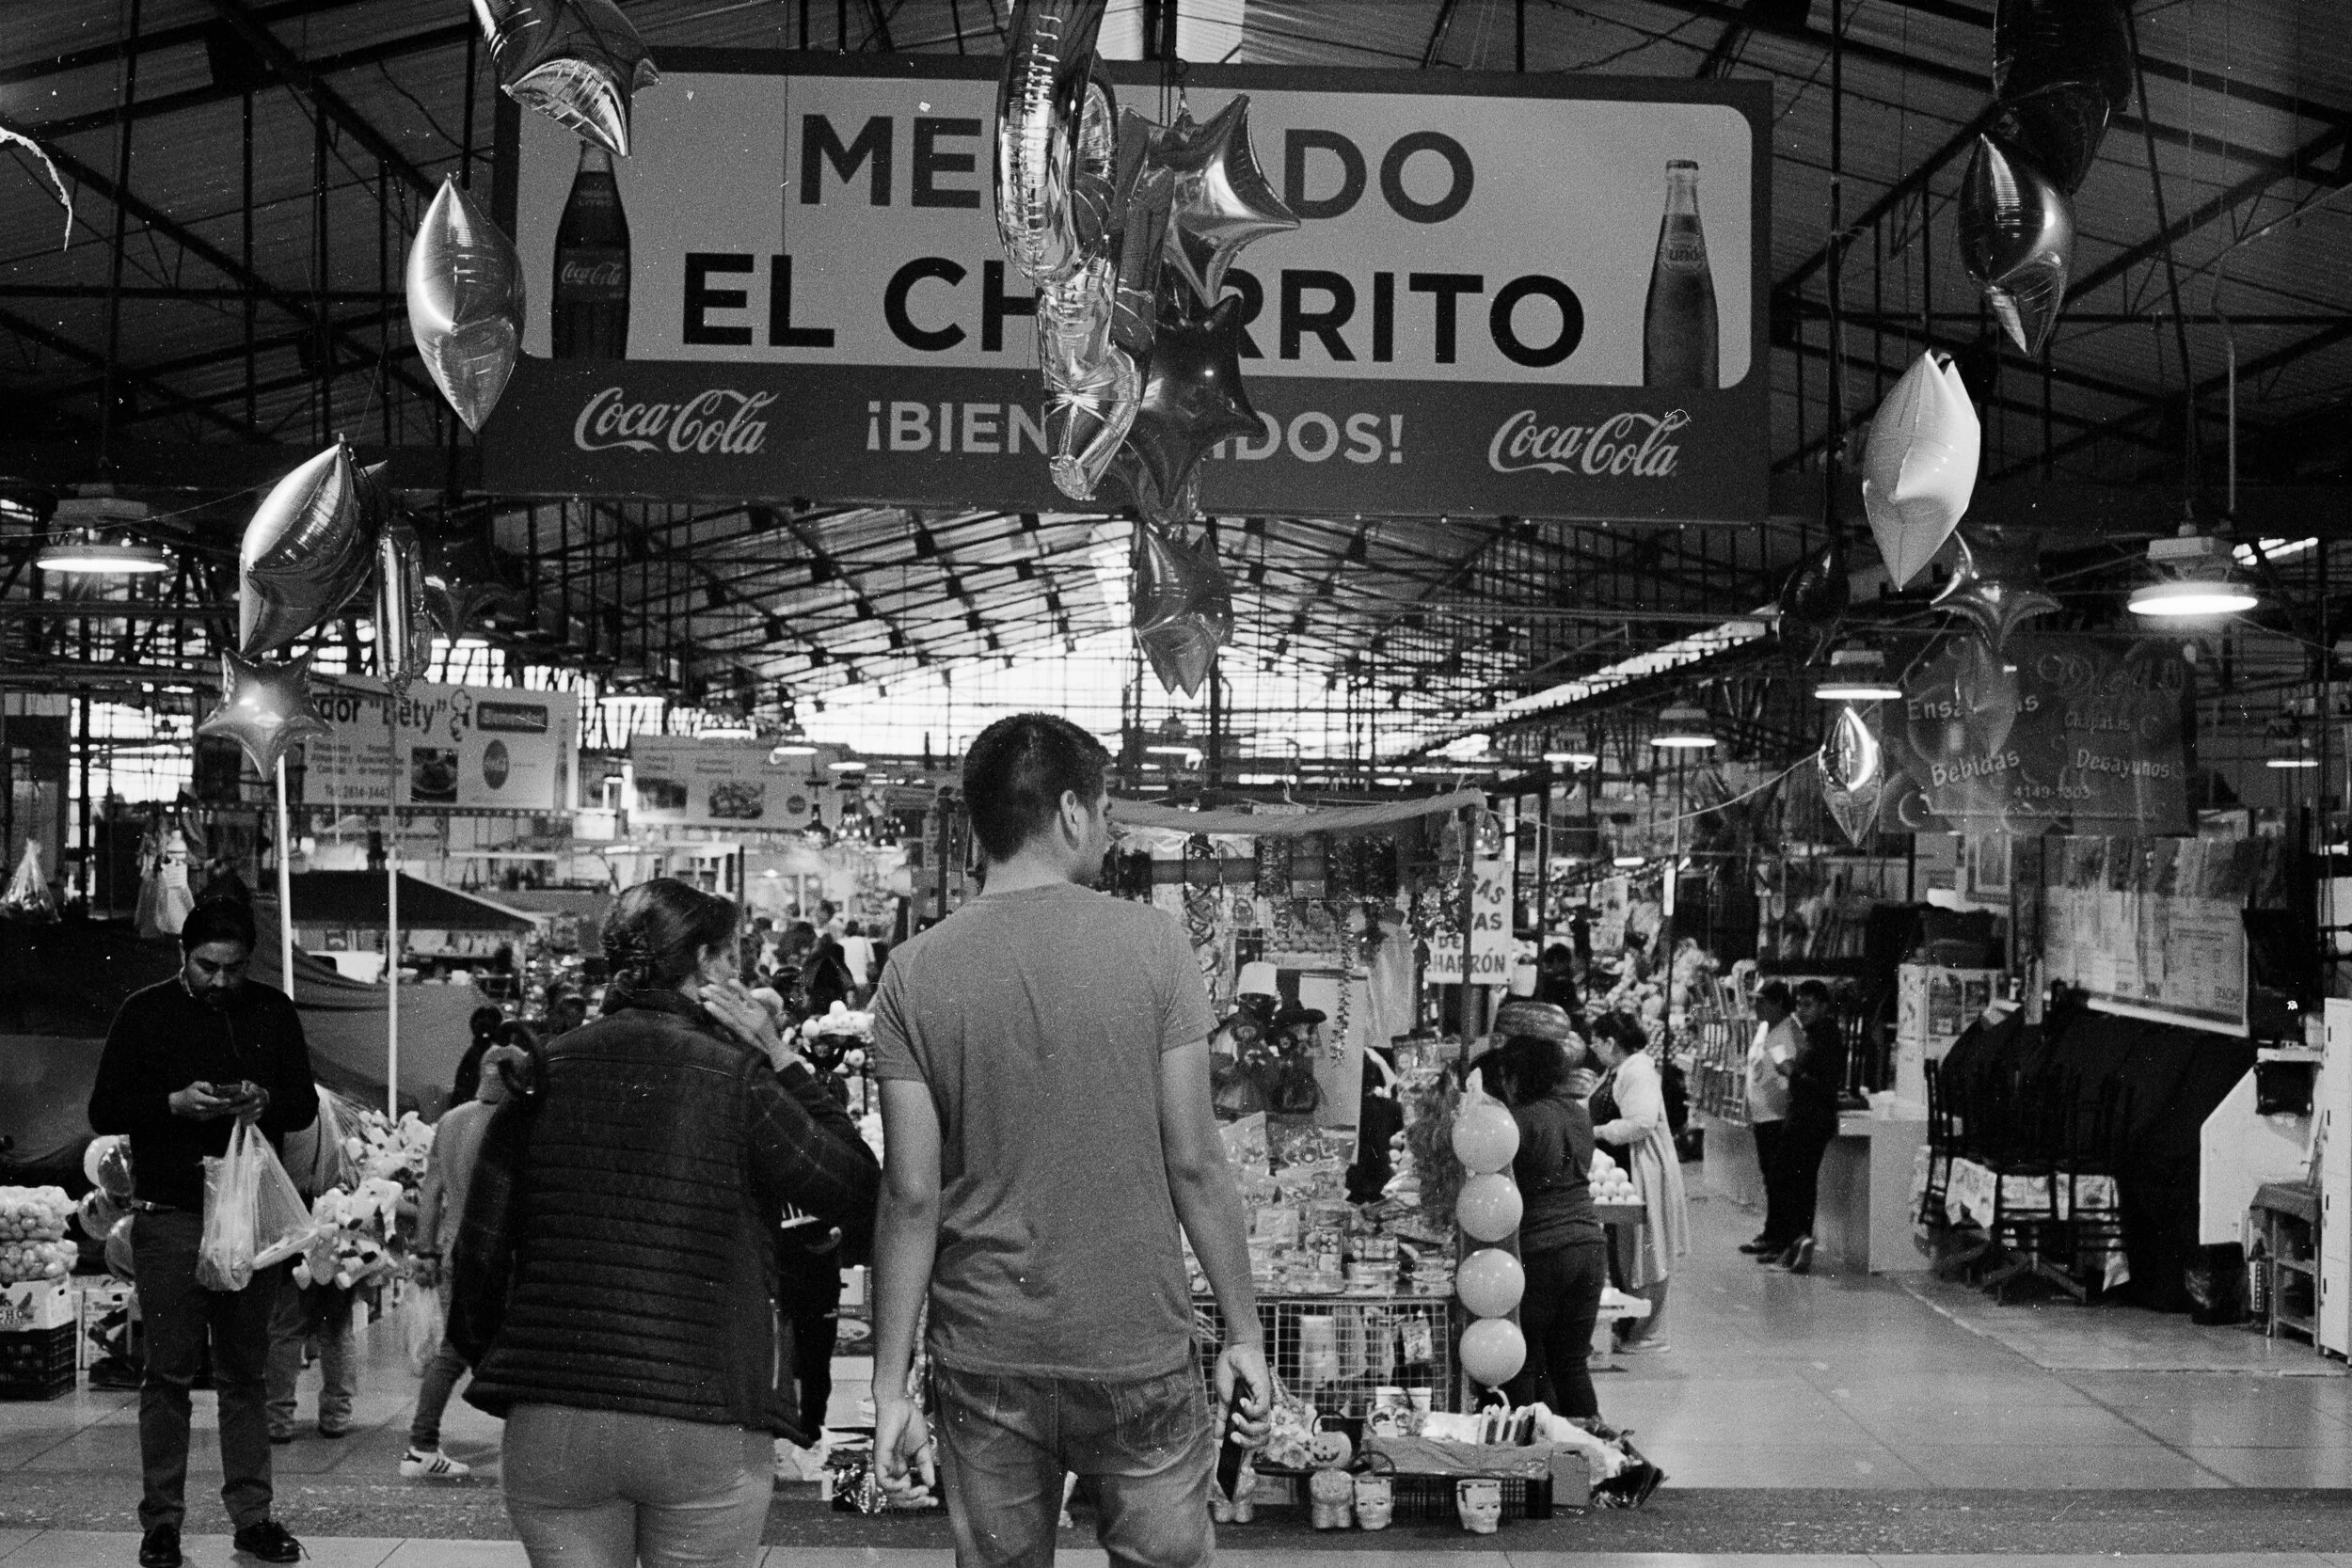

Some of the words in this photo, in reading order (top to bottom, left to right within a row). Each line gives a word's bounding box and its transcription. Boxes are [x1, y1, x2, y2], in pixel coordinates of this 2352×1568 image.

[800, 114, 1475, 224] MEDO
[682, 253, 835, 348] EL
[883, 256, 1584, 368] CHRRITO
[574, 387, 779, 455] Coca-Cola
[866, 400, 1404, 464] ¡BIENDOS!
[1488, 409, 1688, 477] Coca-Cola
[1931, 752, 2020, 787] Bebidas
[2076, 749, 2170, 779] Desayunos
